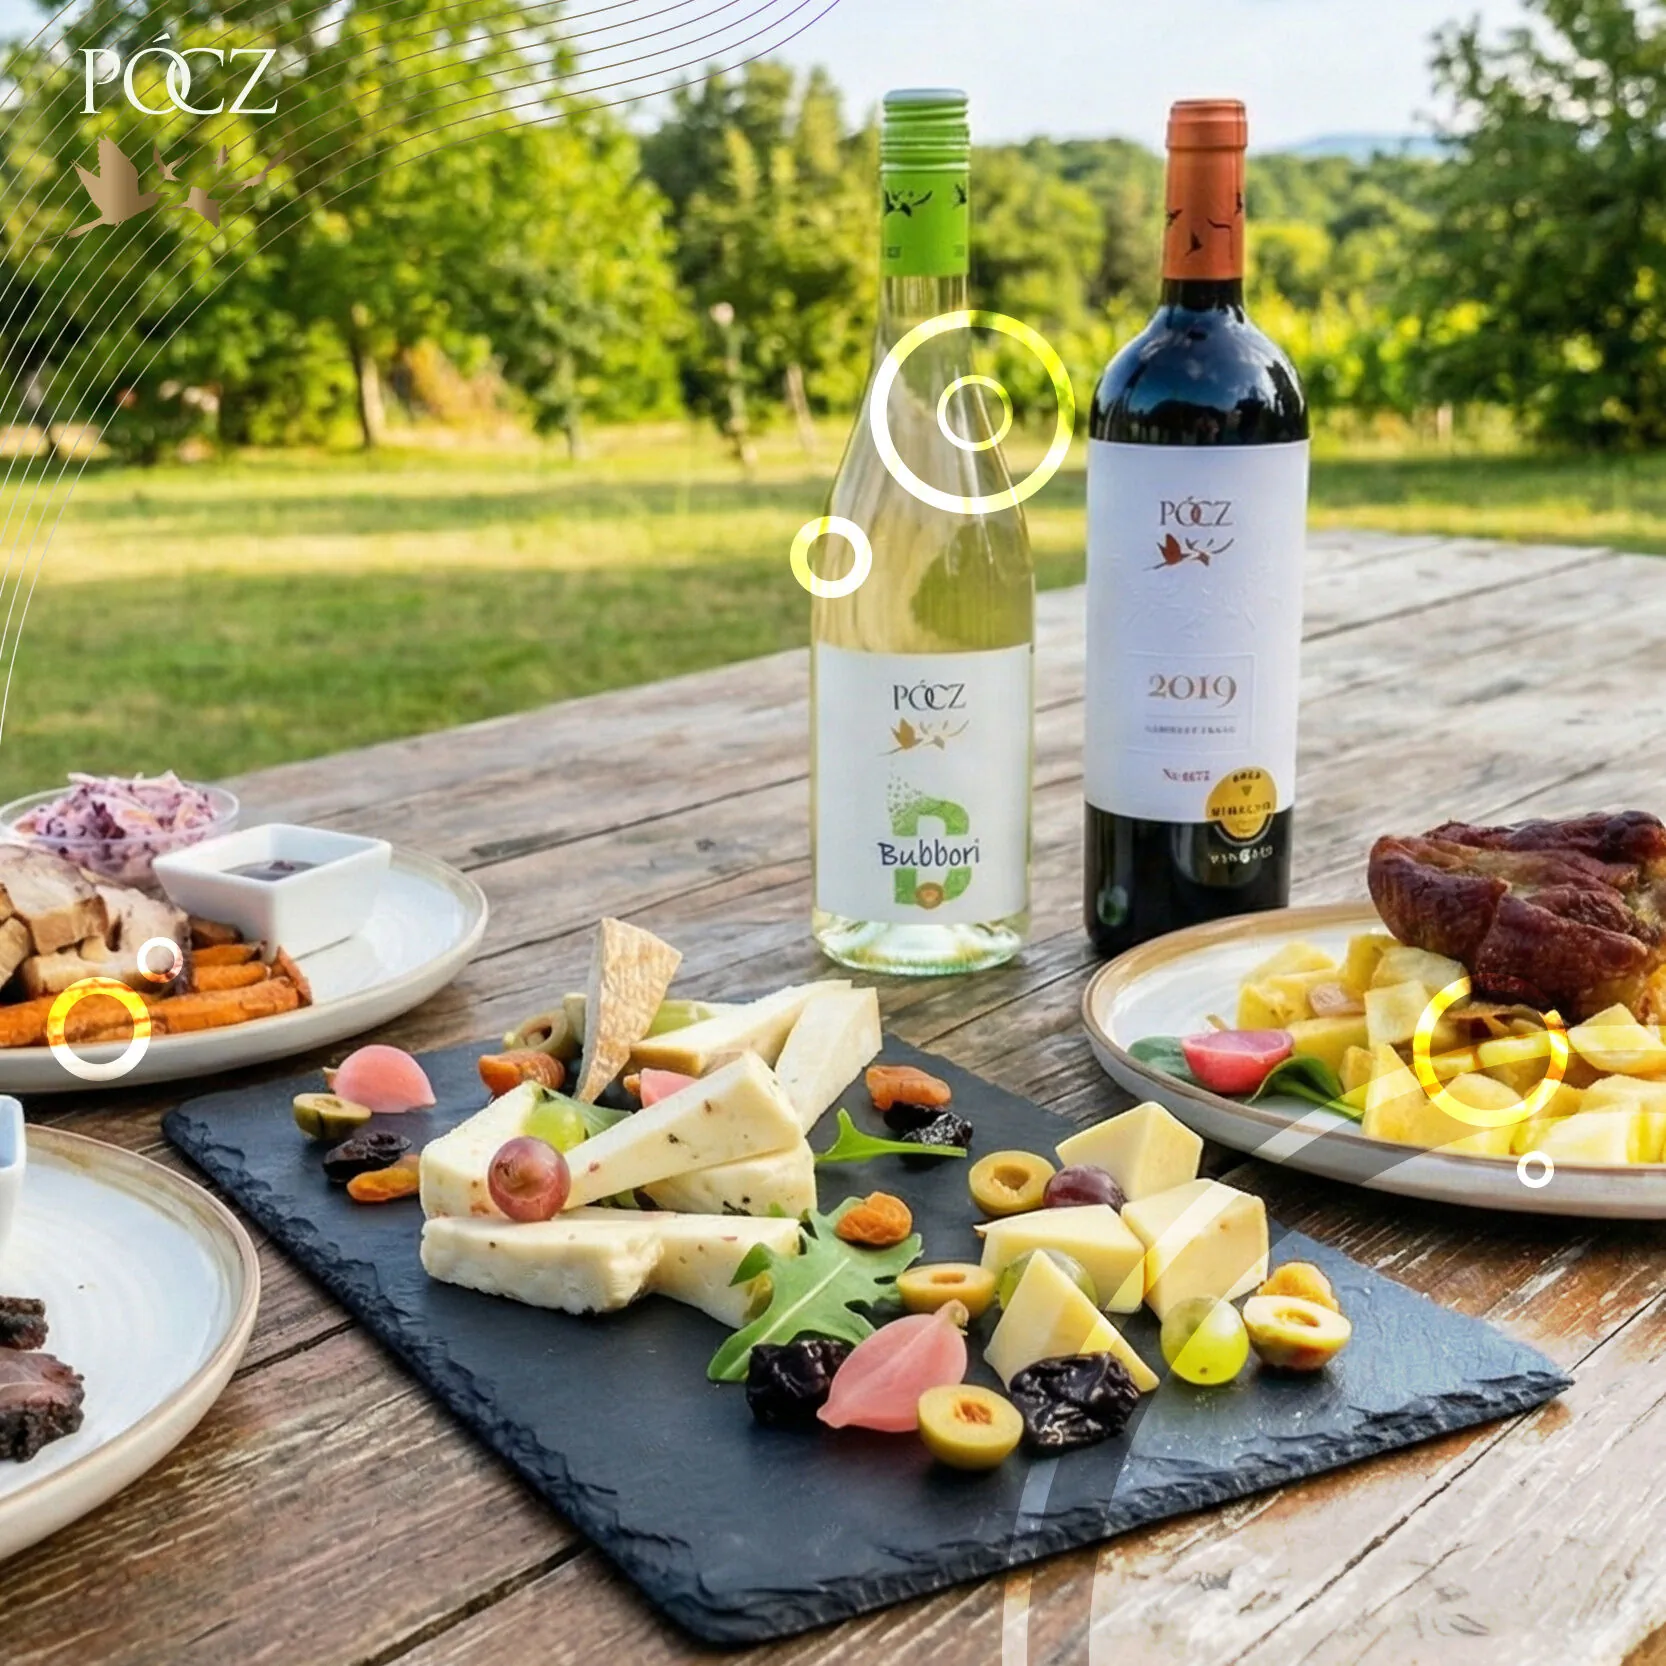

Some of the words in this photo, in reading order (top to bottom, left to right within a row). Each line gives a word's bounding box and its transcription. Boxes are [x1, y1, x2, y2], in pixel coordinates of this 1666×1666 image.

[1158, 495, 1234, 527] PÓCZ
[892, 679, 968, 711] PÓCZ
[1148, 673, 1237, 709] 2019
[877, 837, 981, 868] Bubbori
